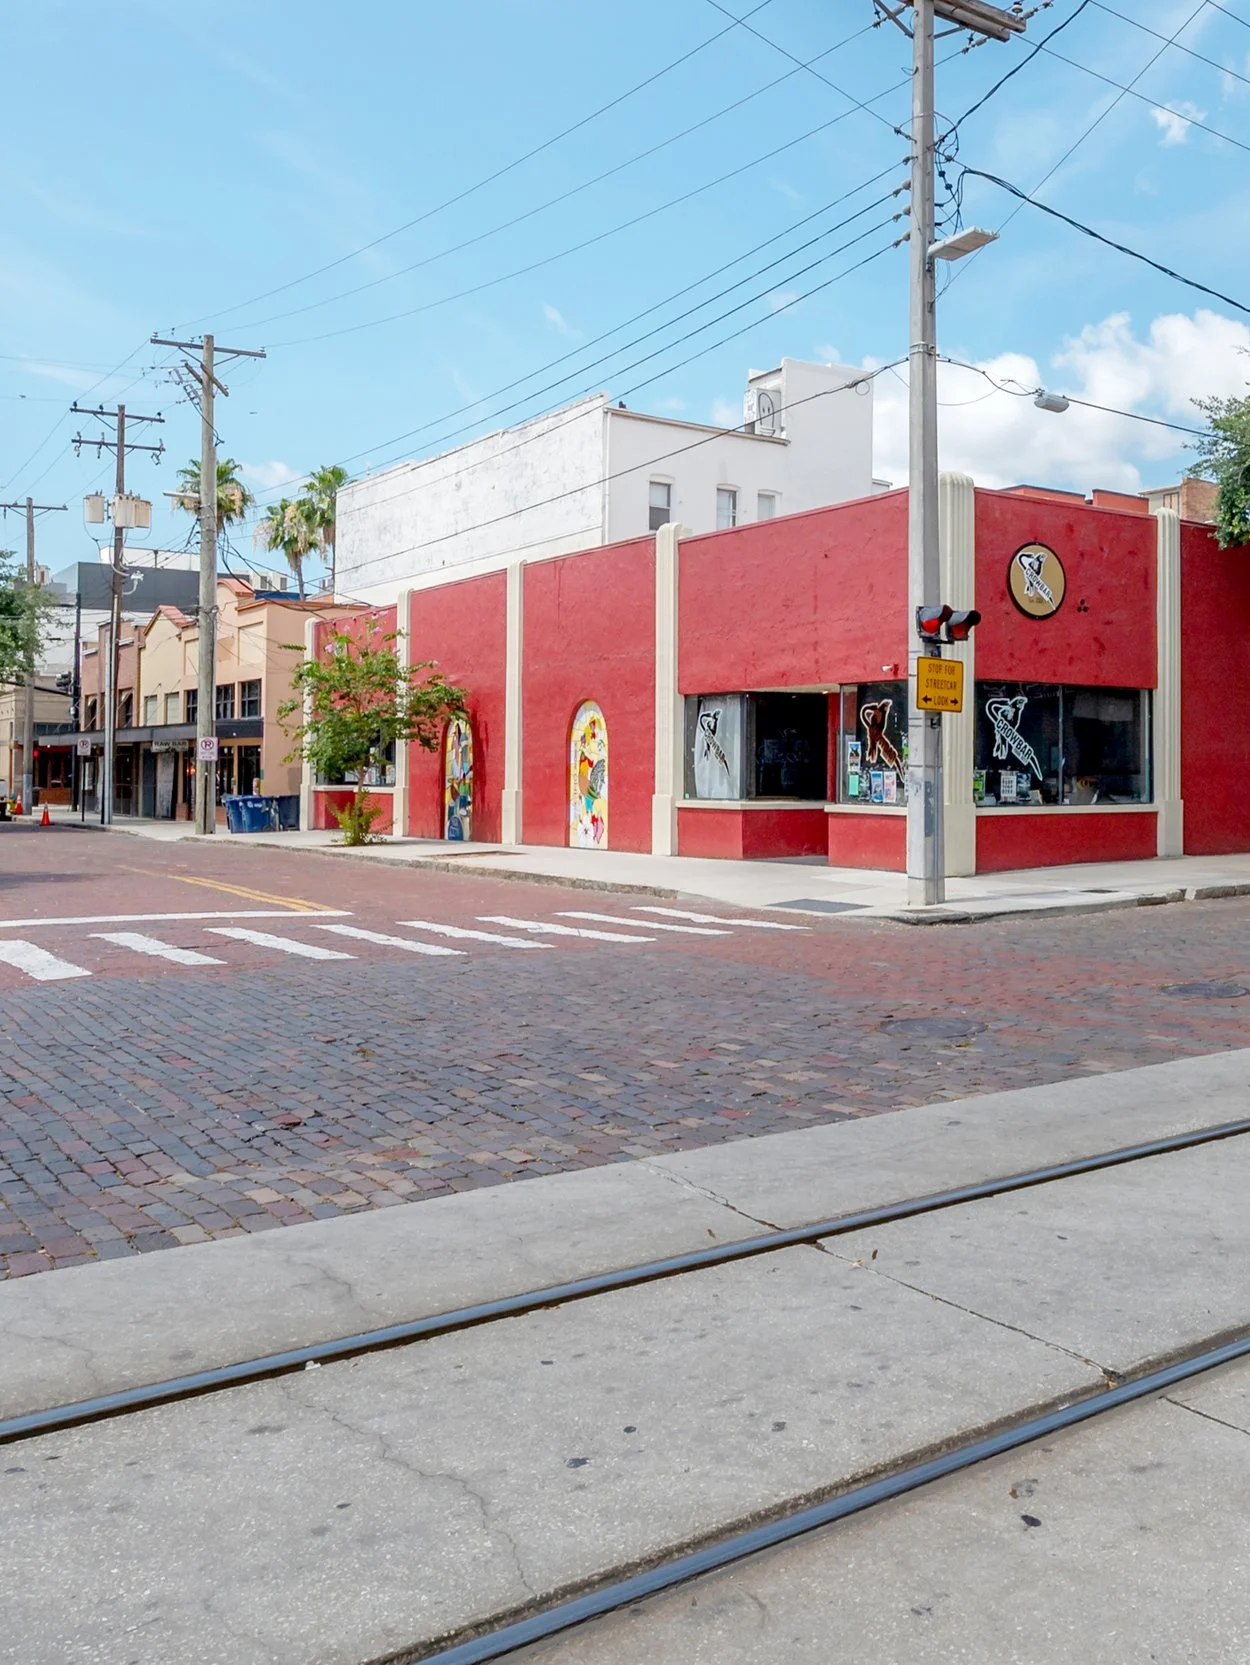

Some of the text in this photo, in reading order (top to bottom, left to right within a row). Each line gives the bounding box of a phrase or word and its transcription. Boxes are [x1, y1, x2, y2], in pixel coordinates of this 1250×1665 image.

[1025, 567, 1051, 598] CROWBAR
[928, 663, 956, 675] STOP FOR
[925, 678, 957, 690] STREETCAR
[933, 695, 949, 706] LOOK
[996, 718, 1034, 760] CROWBAR
